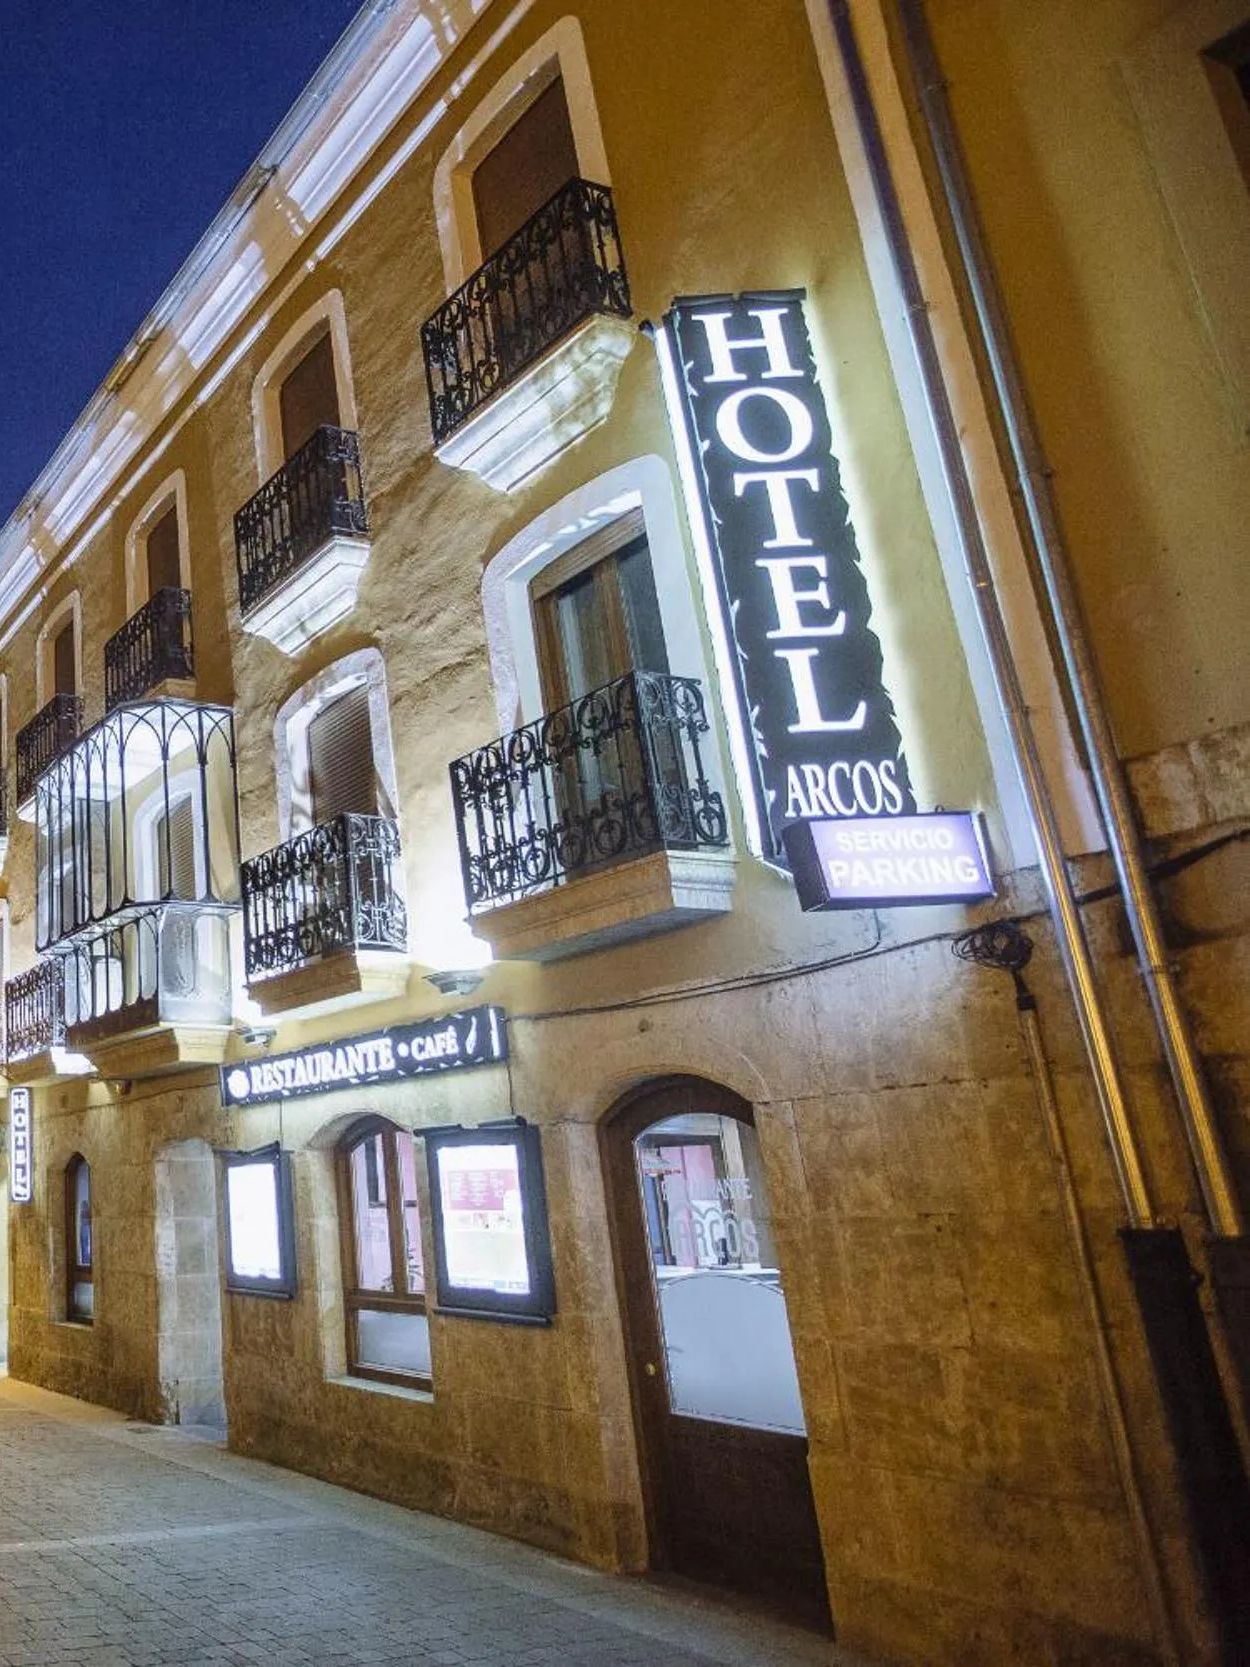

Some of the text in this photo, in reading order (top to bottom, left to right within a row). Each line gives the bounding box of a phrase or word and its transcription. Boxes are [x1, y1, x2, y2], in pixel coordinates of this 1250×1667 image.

[691, 308, 867, 734] HOTEL
[785, 759, 903, 817] ARCOS
[836, 827, 953, 852] SERVICIO
[828, 856, 979, 887] PARKING
[251, 1038, 395, 1094] RESTAURANTE
[12, 1091, 29, 1198] HOTEL
